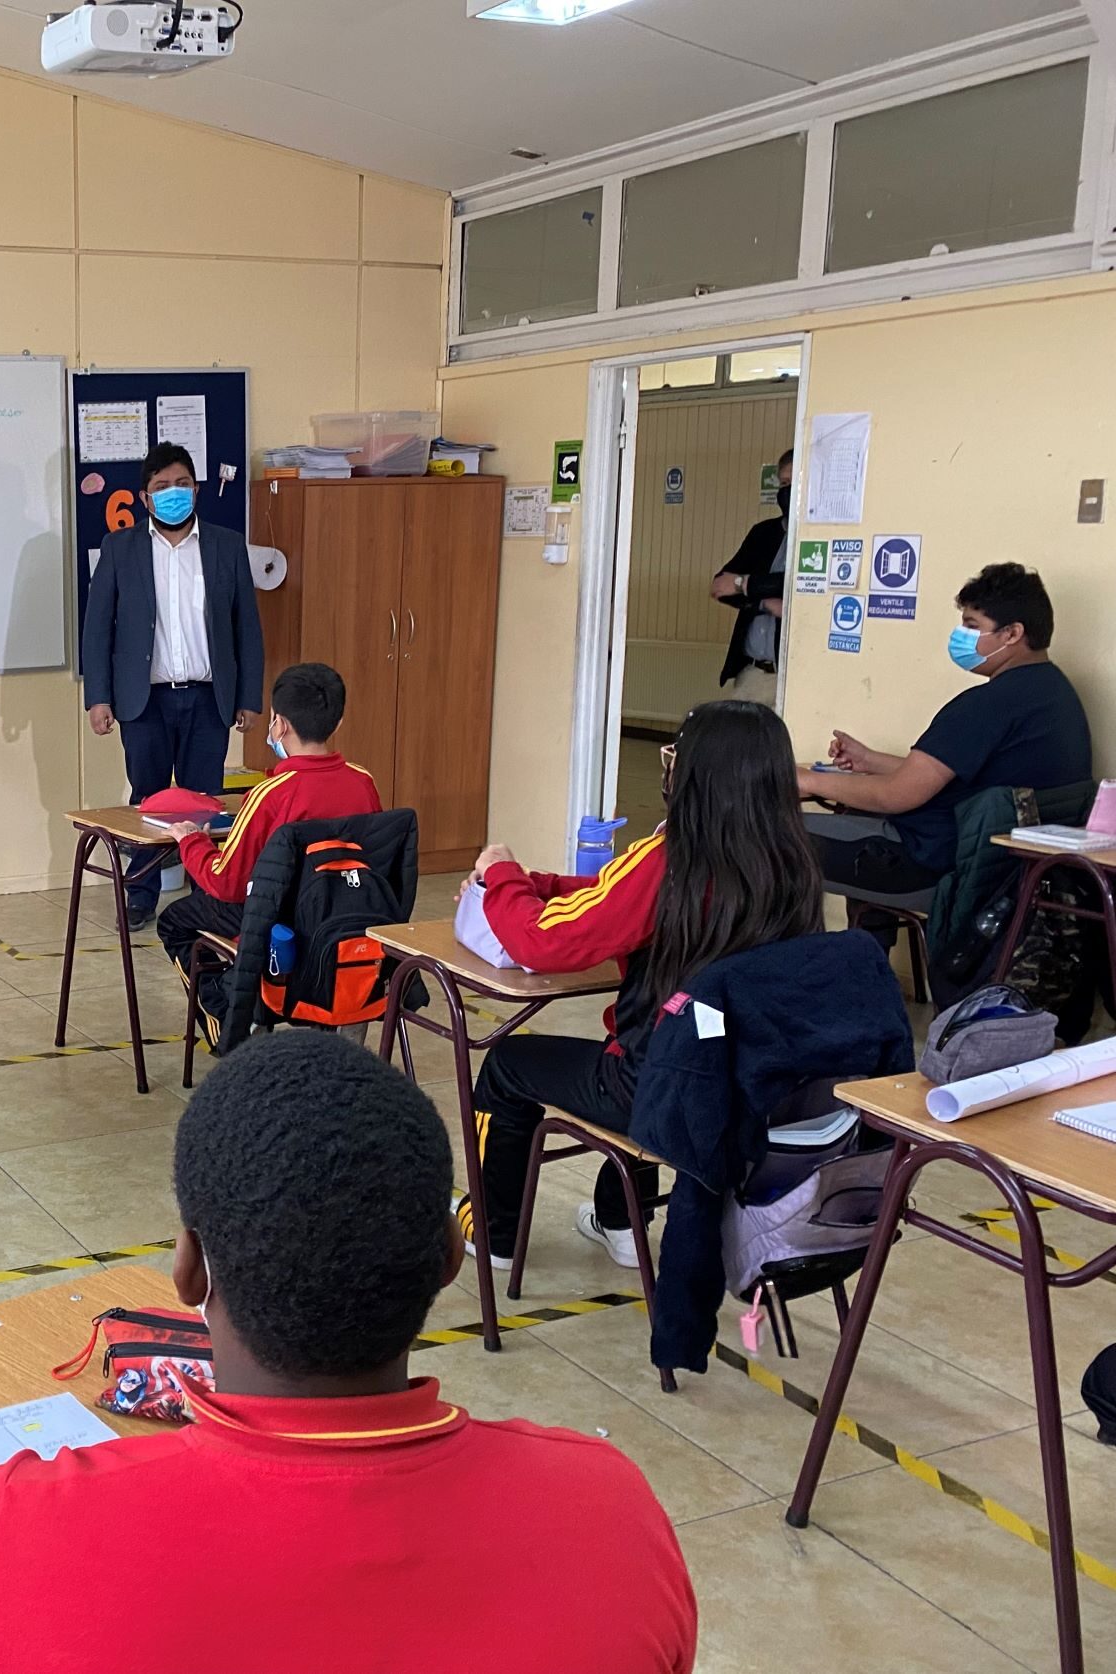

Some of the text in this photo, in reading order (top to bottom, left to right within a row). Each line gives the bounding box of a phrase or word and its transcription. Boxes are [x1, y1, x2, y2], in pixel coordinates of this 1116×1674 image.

[106, 489, 135, 534] 6
[833, 541, 862, 551] AVISO
[868, 606, 915, 616] REGULARMENTE
[830, 640, 859, 651] DISTANCIA
